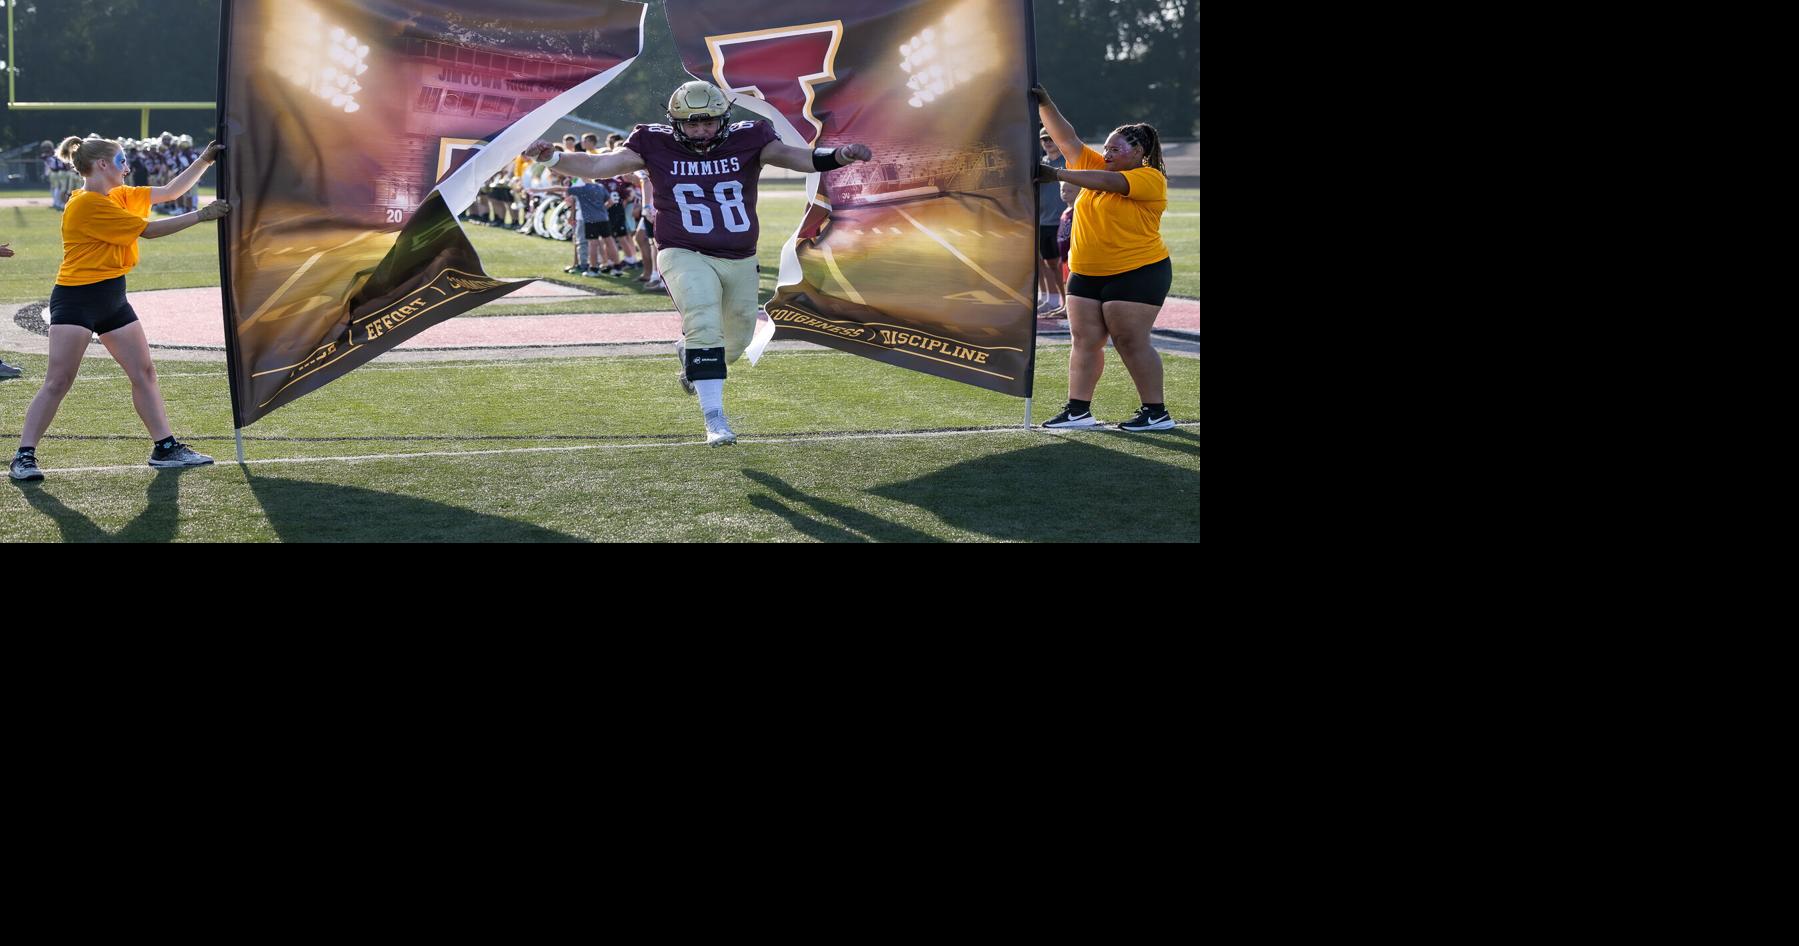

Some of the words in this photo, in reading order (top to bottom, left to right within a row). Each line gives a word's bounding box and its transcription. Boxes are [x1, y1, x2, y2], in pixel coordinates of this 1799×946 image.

[438, 68, 502, 90] JIMTOWN
[670, 157, 740, 176] JIMMIES
[386, 209, 403, 223] 20
[672, 180, 751, 234] 68
[365, 297, 427, 341] EFFORT
[879, 329, 990, 364] DISCIPLINE
